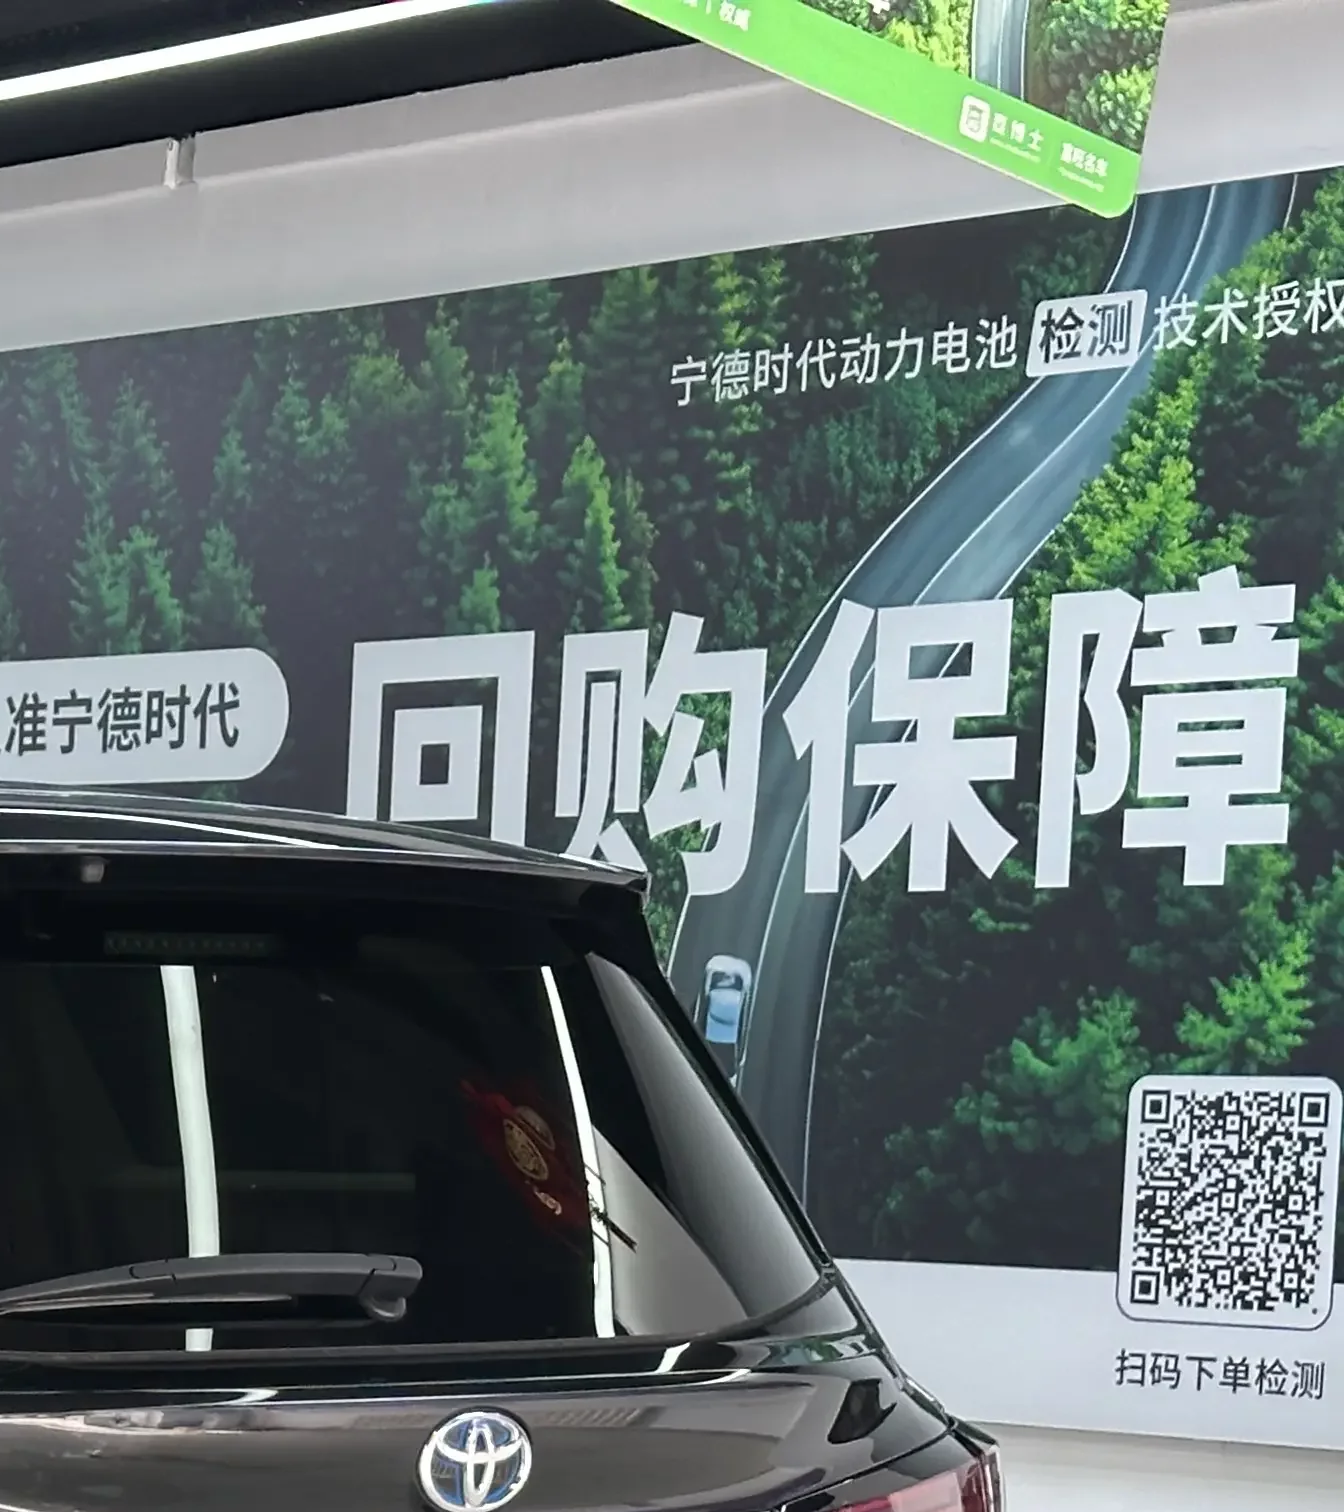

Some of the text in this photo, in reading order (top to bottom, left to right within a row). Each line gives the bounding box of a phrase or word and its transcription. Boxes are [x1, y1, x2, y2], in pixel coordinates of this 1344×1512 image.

[670, 277, 1344, 406] 宁德时代动力电池 检测 技术授权
[346, 564, 1300, 897] 回购保障
[1114, 1348, 1326, 1400] 扫码下单检测
